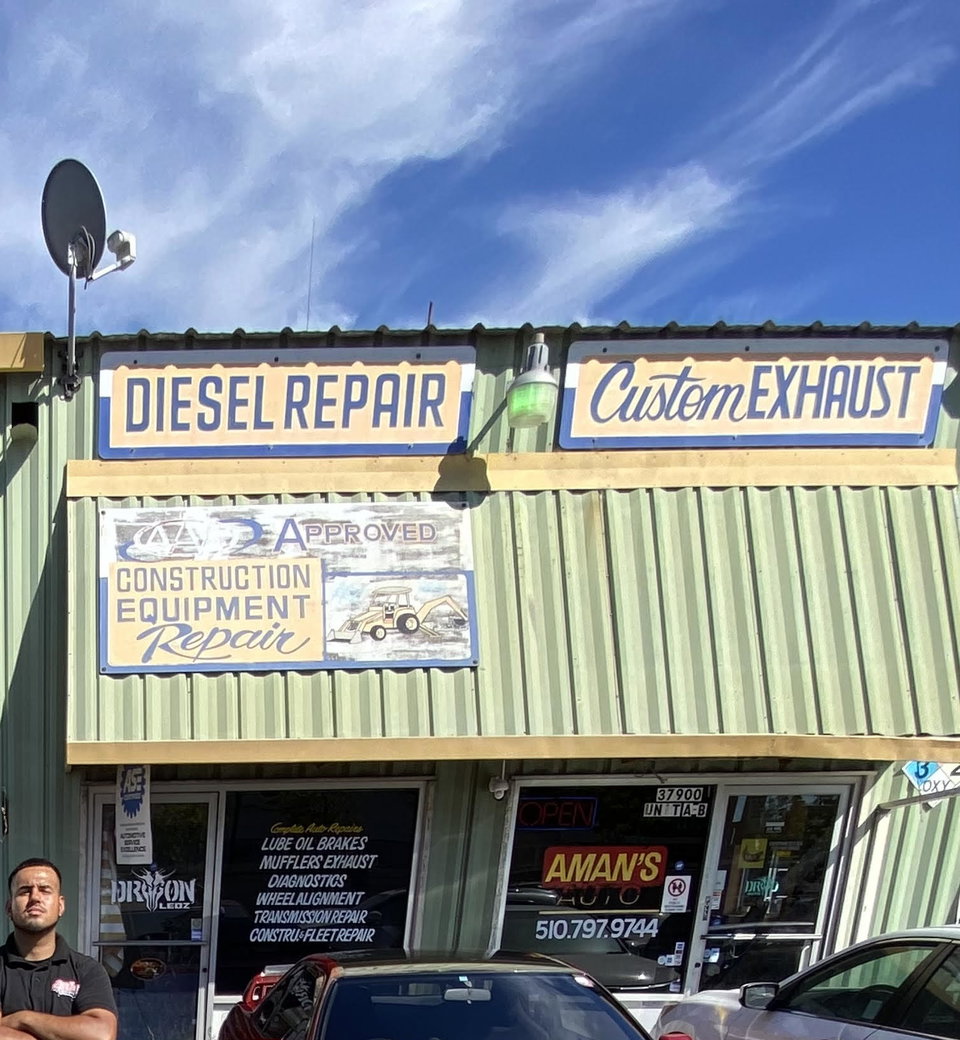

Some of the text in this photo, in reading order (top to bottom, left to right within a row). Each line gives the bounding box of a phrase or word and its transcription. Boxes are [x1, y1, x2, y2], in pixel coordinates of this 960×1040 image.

[588, 360, 920, 423] Custom EXHAUST
[125, 373, 446, 432] DIESEL REPAIR
[116, 563, 311, 592] CONSTRUCTION
[117, 594, 311, 625] EQUIPMENT
[136, 622, 310, 663] Repair
[657, 788, 702, 801] 37900
[519, 801, 594, 826] OPEN
[644, 804, 681, 816] UNT
[305, 823, 328, 833] Auto
[261, 836, 368, 851] LUBE OIL BRAKES
[259, 854, 378, 869] MUFFLERS EXHAUST
[544, 852, 662, 883] AMAN'S
[267, 874, 348, 888] DIAGNOSTICS
[255, 891, 366, 906] WHEEL ALIGNMENT
[556, 886, 641, 906] AUTO
[159, 902, 191, 910] LEDZ
[253, 910, 368, 924] TRANSMISSION REPAIR
[303, 928, 340, 943] FLEET
[339, 928, 376, 943] REPAIR
[535, 918, 659, 940] 510.797.9744
